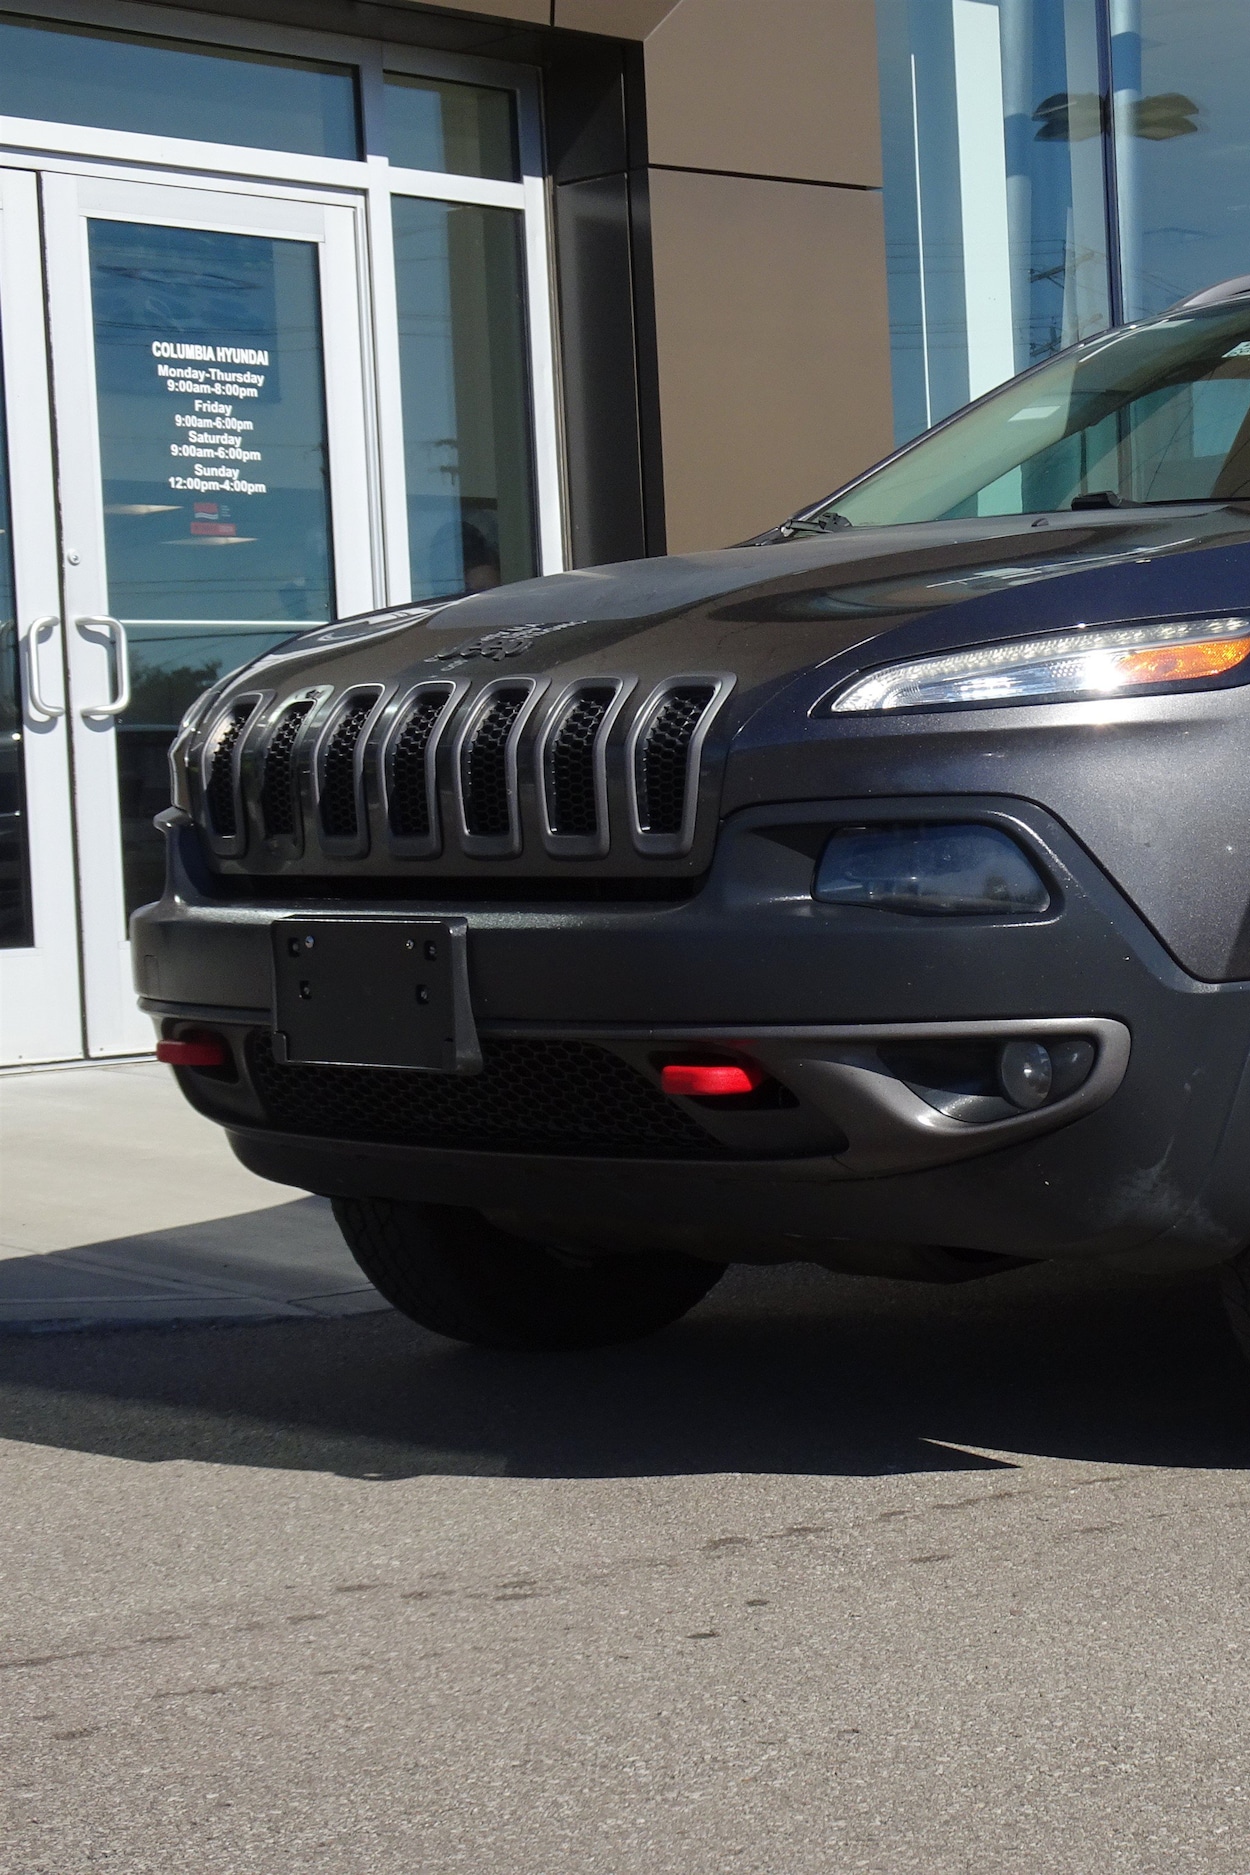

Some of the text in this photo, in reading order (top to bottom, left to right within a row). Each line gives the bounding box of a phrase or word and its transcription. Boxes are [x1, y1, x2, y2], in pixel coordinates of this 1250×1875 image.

[152, 341, 268, 365] COLUMBIA HYUNDAI
[157, 364, 264, 386] Monday-Thursday
[167, 379, 258, 398] 9:00am-8:00pm
[194, 400, 231, 415] Friday
[174, 414, 253, 431] 9:00am-6:00pm
[188, 431, 241, 447] Saturday
[170, 444, 261, 461] 9:00am-6:00pm
[194, 463, 239, 479] Sunday
[168, 476, 266, 494] 12:00pm-4:00pm
